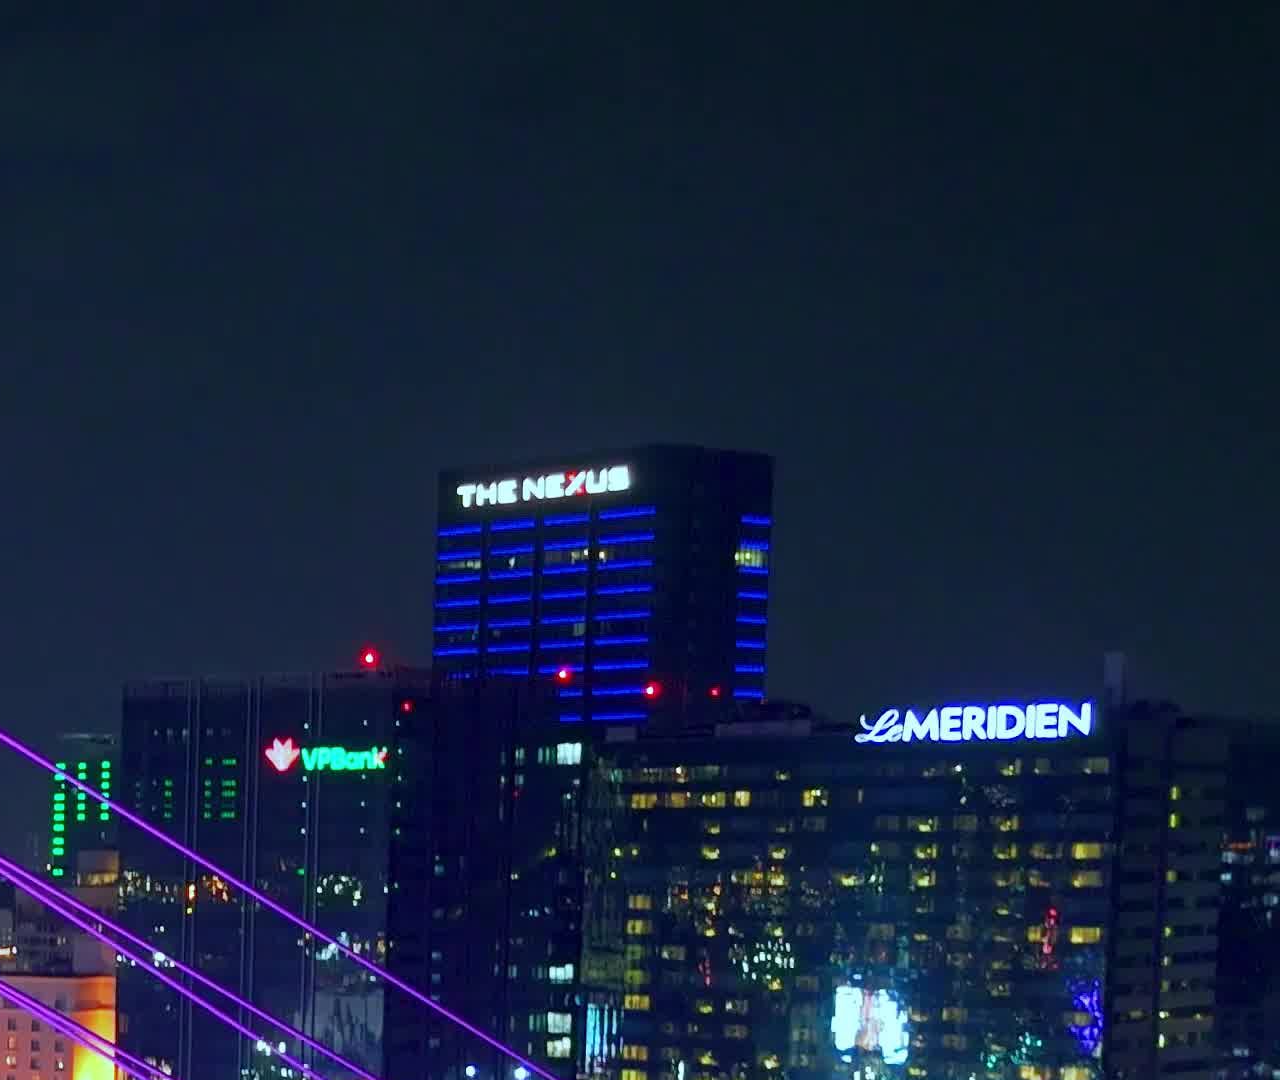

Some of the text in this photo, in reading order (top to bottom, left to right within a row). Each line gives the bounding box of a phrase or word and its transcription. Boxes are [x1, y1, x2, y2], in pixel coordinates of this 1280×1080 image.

[456, 464, 630, 508] THE NEXUS
[301, 746, 388, 771] VPBank
